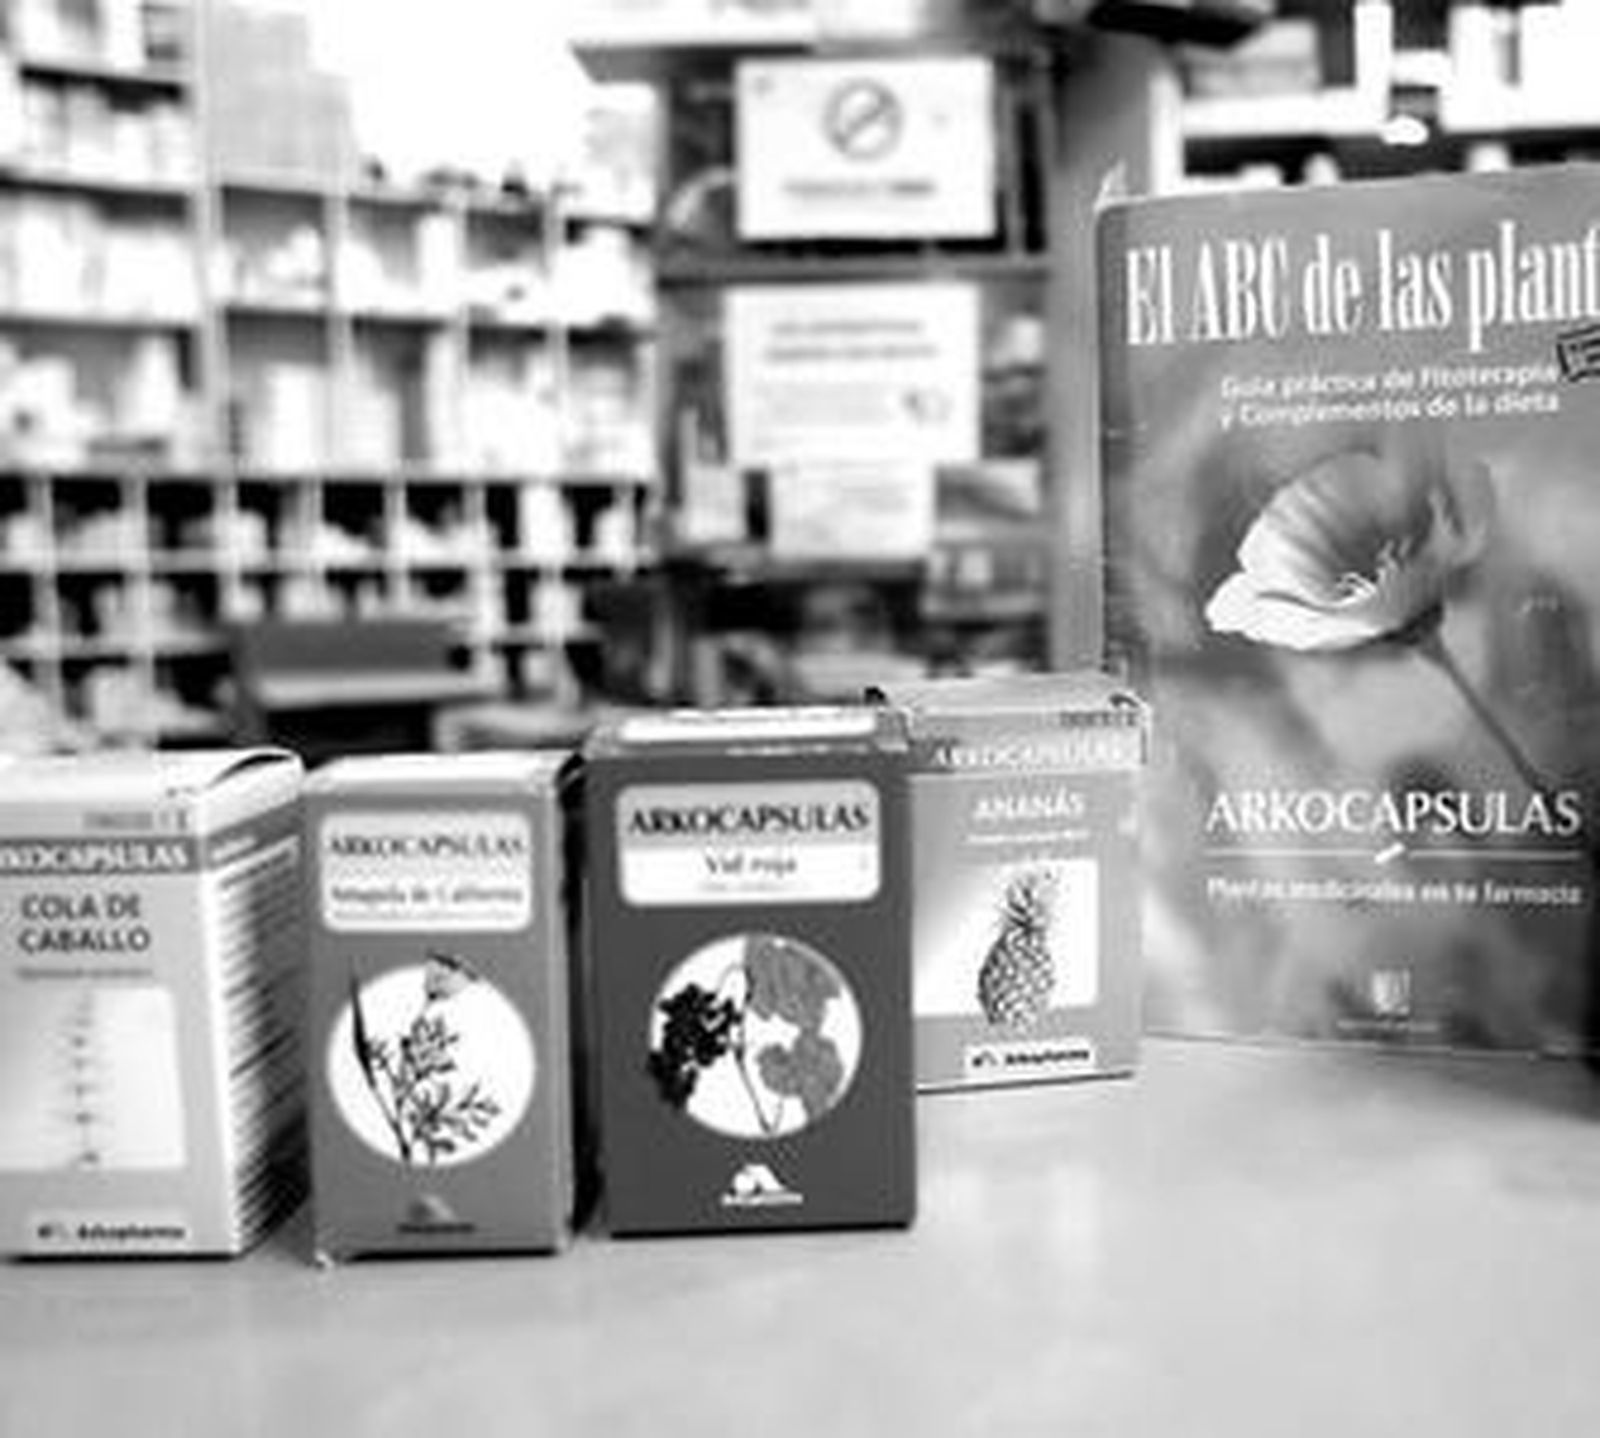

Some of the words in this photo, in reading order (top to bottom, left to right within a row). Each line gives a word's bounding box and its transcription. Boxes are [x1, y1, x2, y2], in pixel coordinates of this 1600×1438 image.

[1126, 244, 1175, 346] El
[1190, 236, 1291, 342] ABC
[1303, 232, 1363, 335] de
[1378, 228, 1453, 332] las
[1426, 396, 1458, 418] de
[1463, 392, 1489, 417] la
[1493, 391, 1560, 415] dieta
[628, 803, 870, 836] ARKOCAPSULAS
[1205, 789, 1582, 837] ARKOCAPSULAS
[21, 894, 99, 920] COLA
[107, 894, 140, 920] DE
[19, 926, 151, 953] CABALLO
